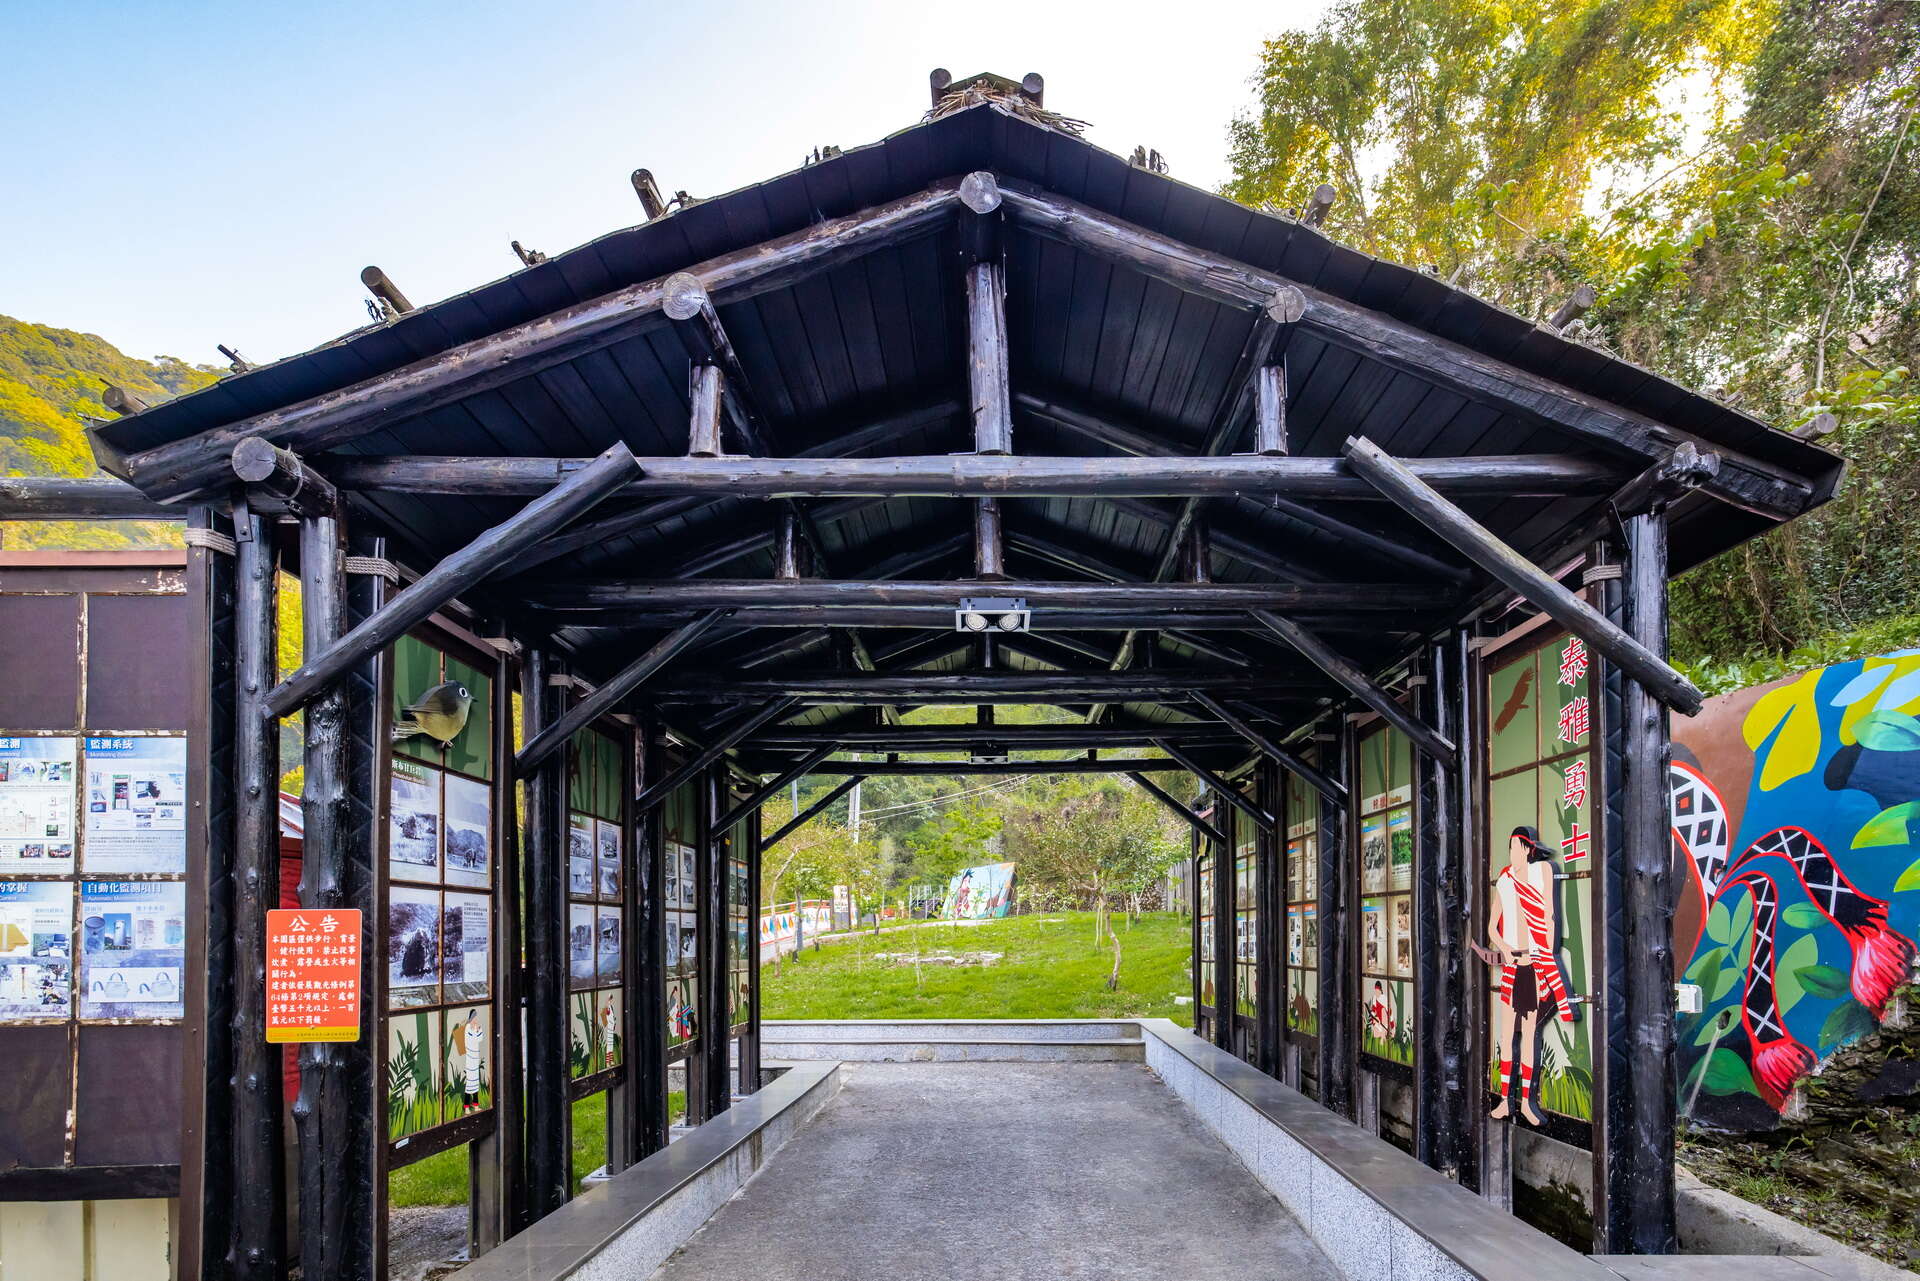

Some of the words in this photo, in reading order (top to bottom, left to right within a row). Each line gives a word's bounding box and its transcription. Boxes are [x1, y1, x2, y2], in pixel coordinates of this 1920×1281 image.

[90, 738, 134, 750] 監測系統
[1557, 637, 1590, 863] 泰雅勇士
[88, 881, 161, 893] 自動化監測項目
[288, 914, 340, 933] 公告
